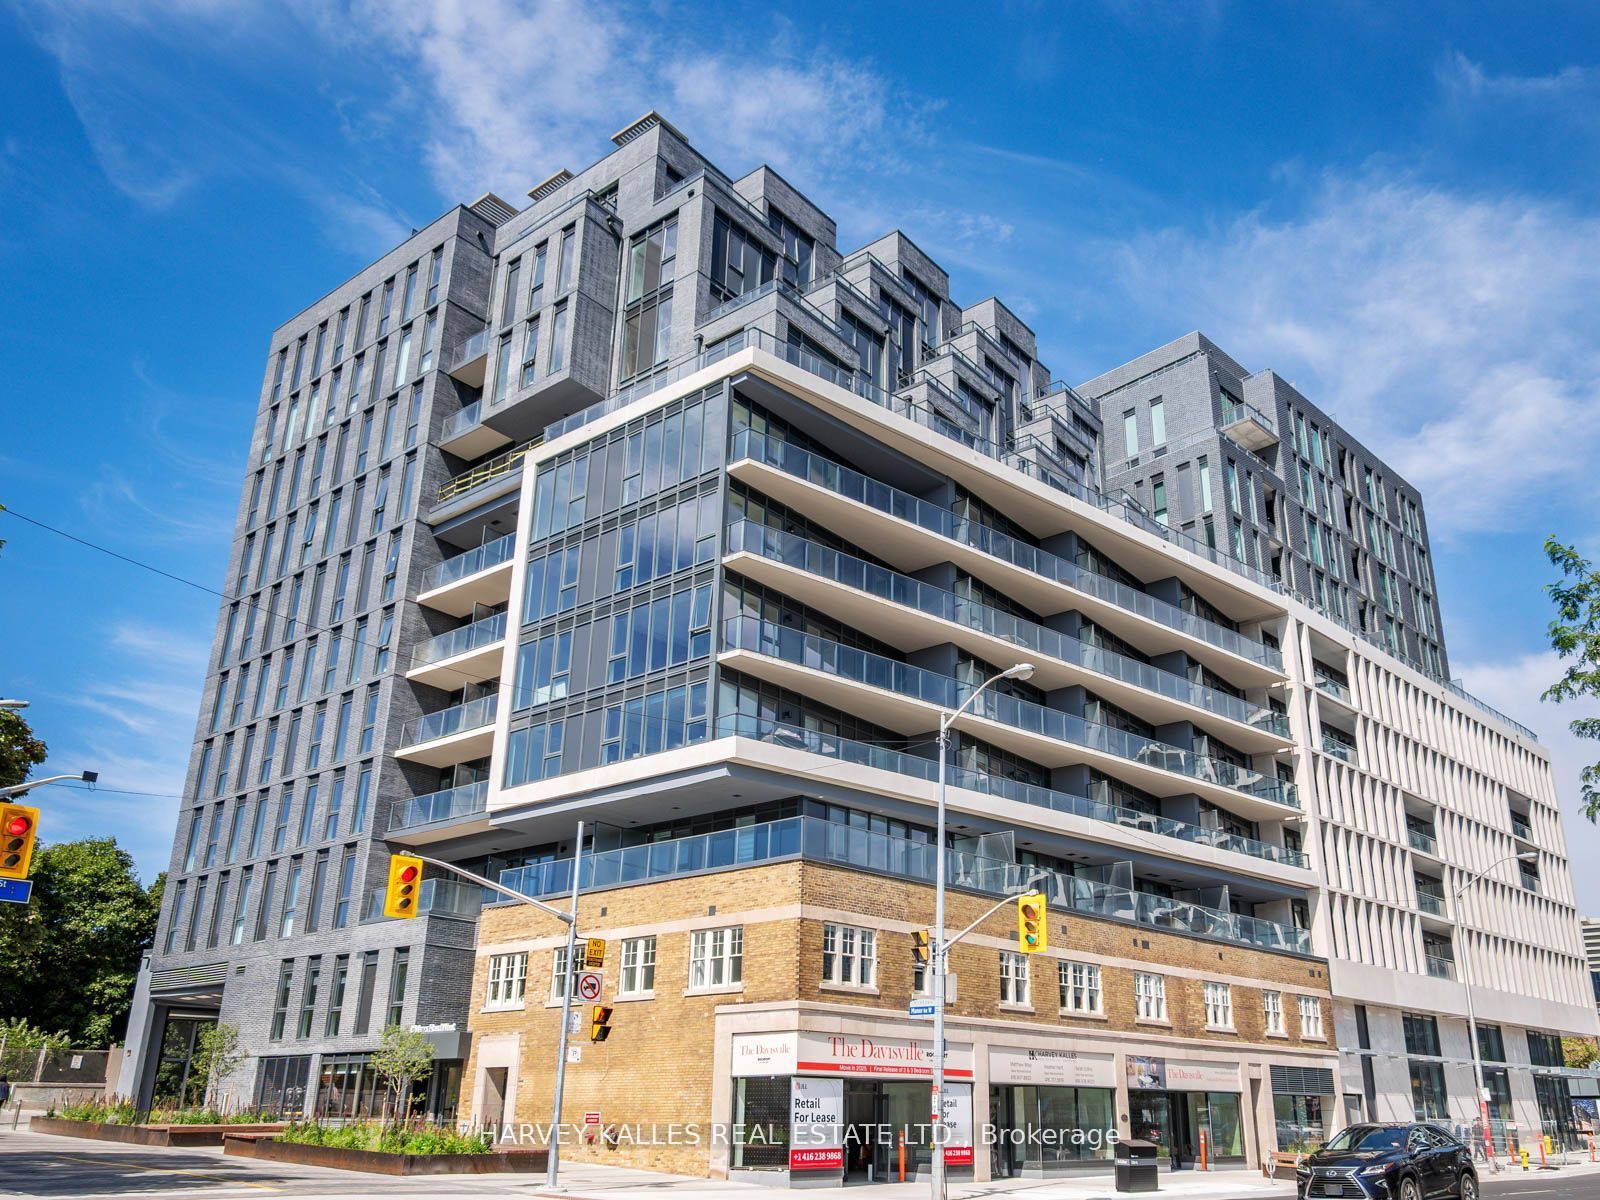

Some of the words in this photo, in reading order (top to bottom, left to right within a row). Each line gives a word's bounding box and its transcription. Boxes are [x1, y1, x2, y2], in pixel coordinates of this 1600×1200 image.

[592, 940, 602, 948] NO
[589, 949, 602, 957] EXIT
[740, 1044, 755, 1056] The
[756, 1043, 791, 1055] Davisville
[828, 1036, 858, 1058] The
[861, 1038, 924, 1061] Davisville
[794, 1098, 820, 1109] Retail
[943, 1099, 958, 1108] etail
[794, 1112, 809, 1123] For
[811, 1112, 836, 1123] Lease
[943, 1121, 957, 1129] ease
[793, 1152, 802, 1161] +1
[802, 1152, 814, 1161] 416
[814, 1152, 826, 1161] 238
